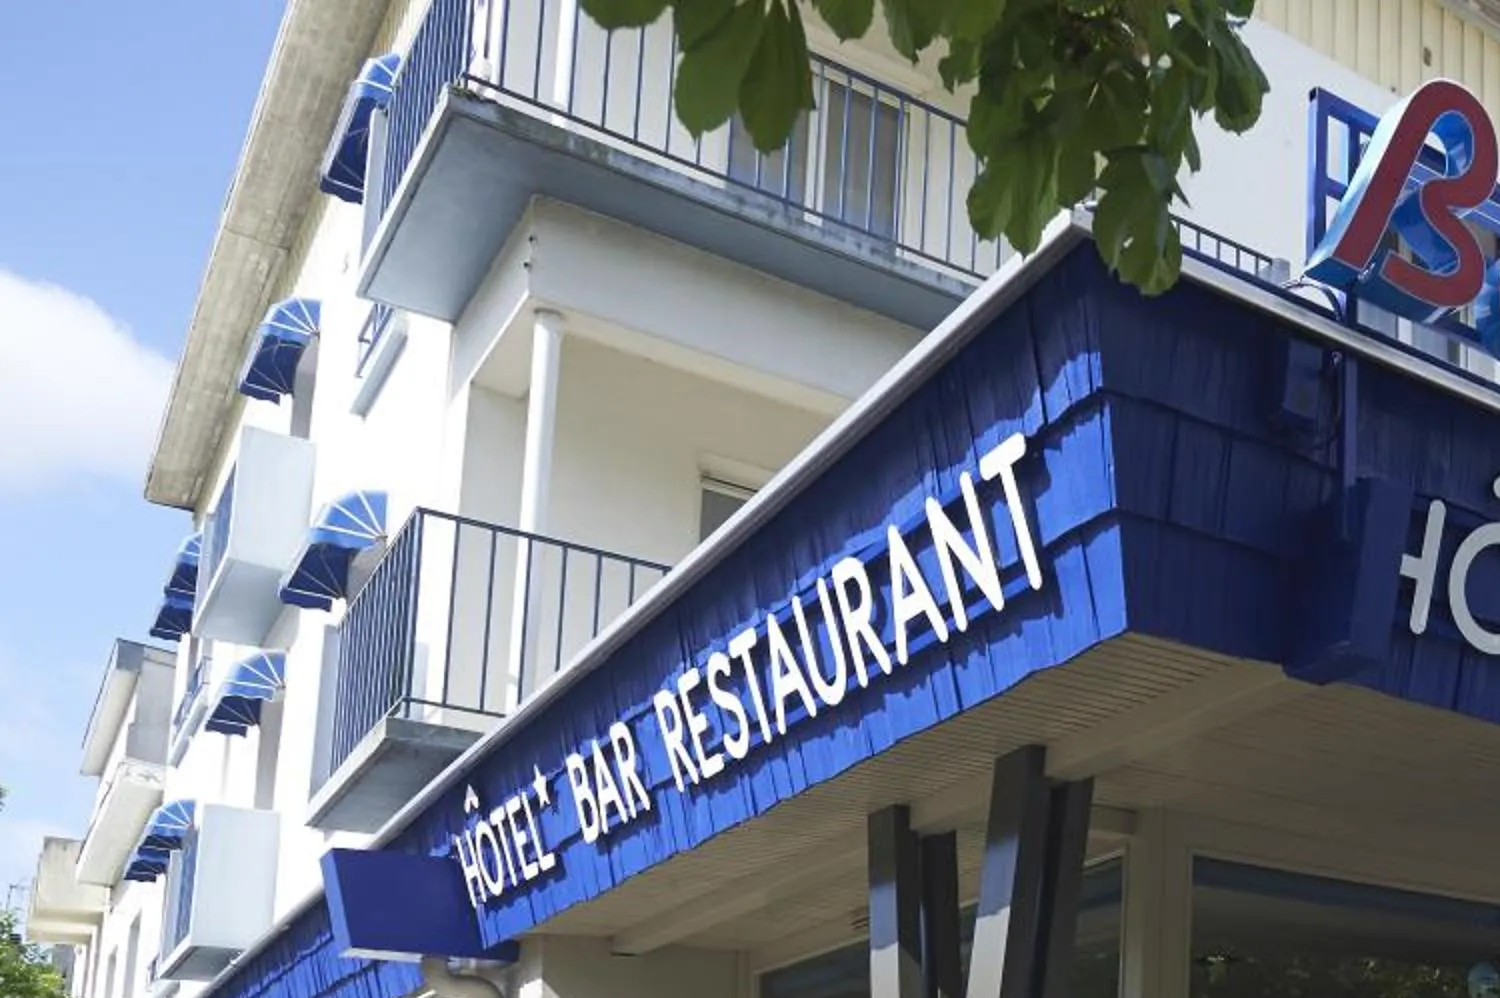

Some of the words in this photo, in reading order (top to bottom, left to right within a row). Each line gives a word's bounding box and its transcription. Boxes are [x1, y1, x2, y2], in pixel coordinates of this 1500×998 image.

[455, 784, 555, 908] HÔTEL
[565, 720, 651, 845] BAR
[653, 432, 1043, 793] RESTAURANT
